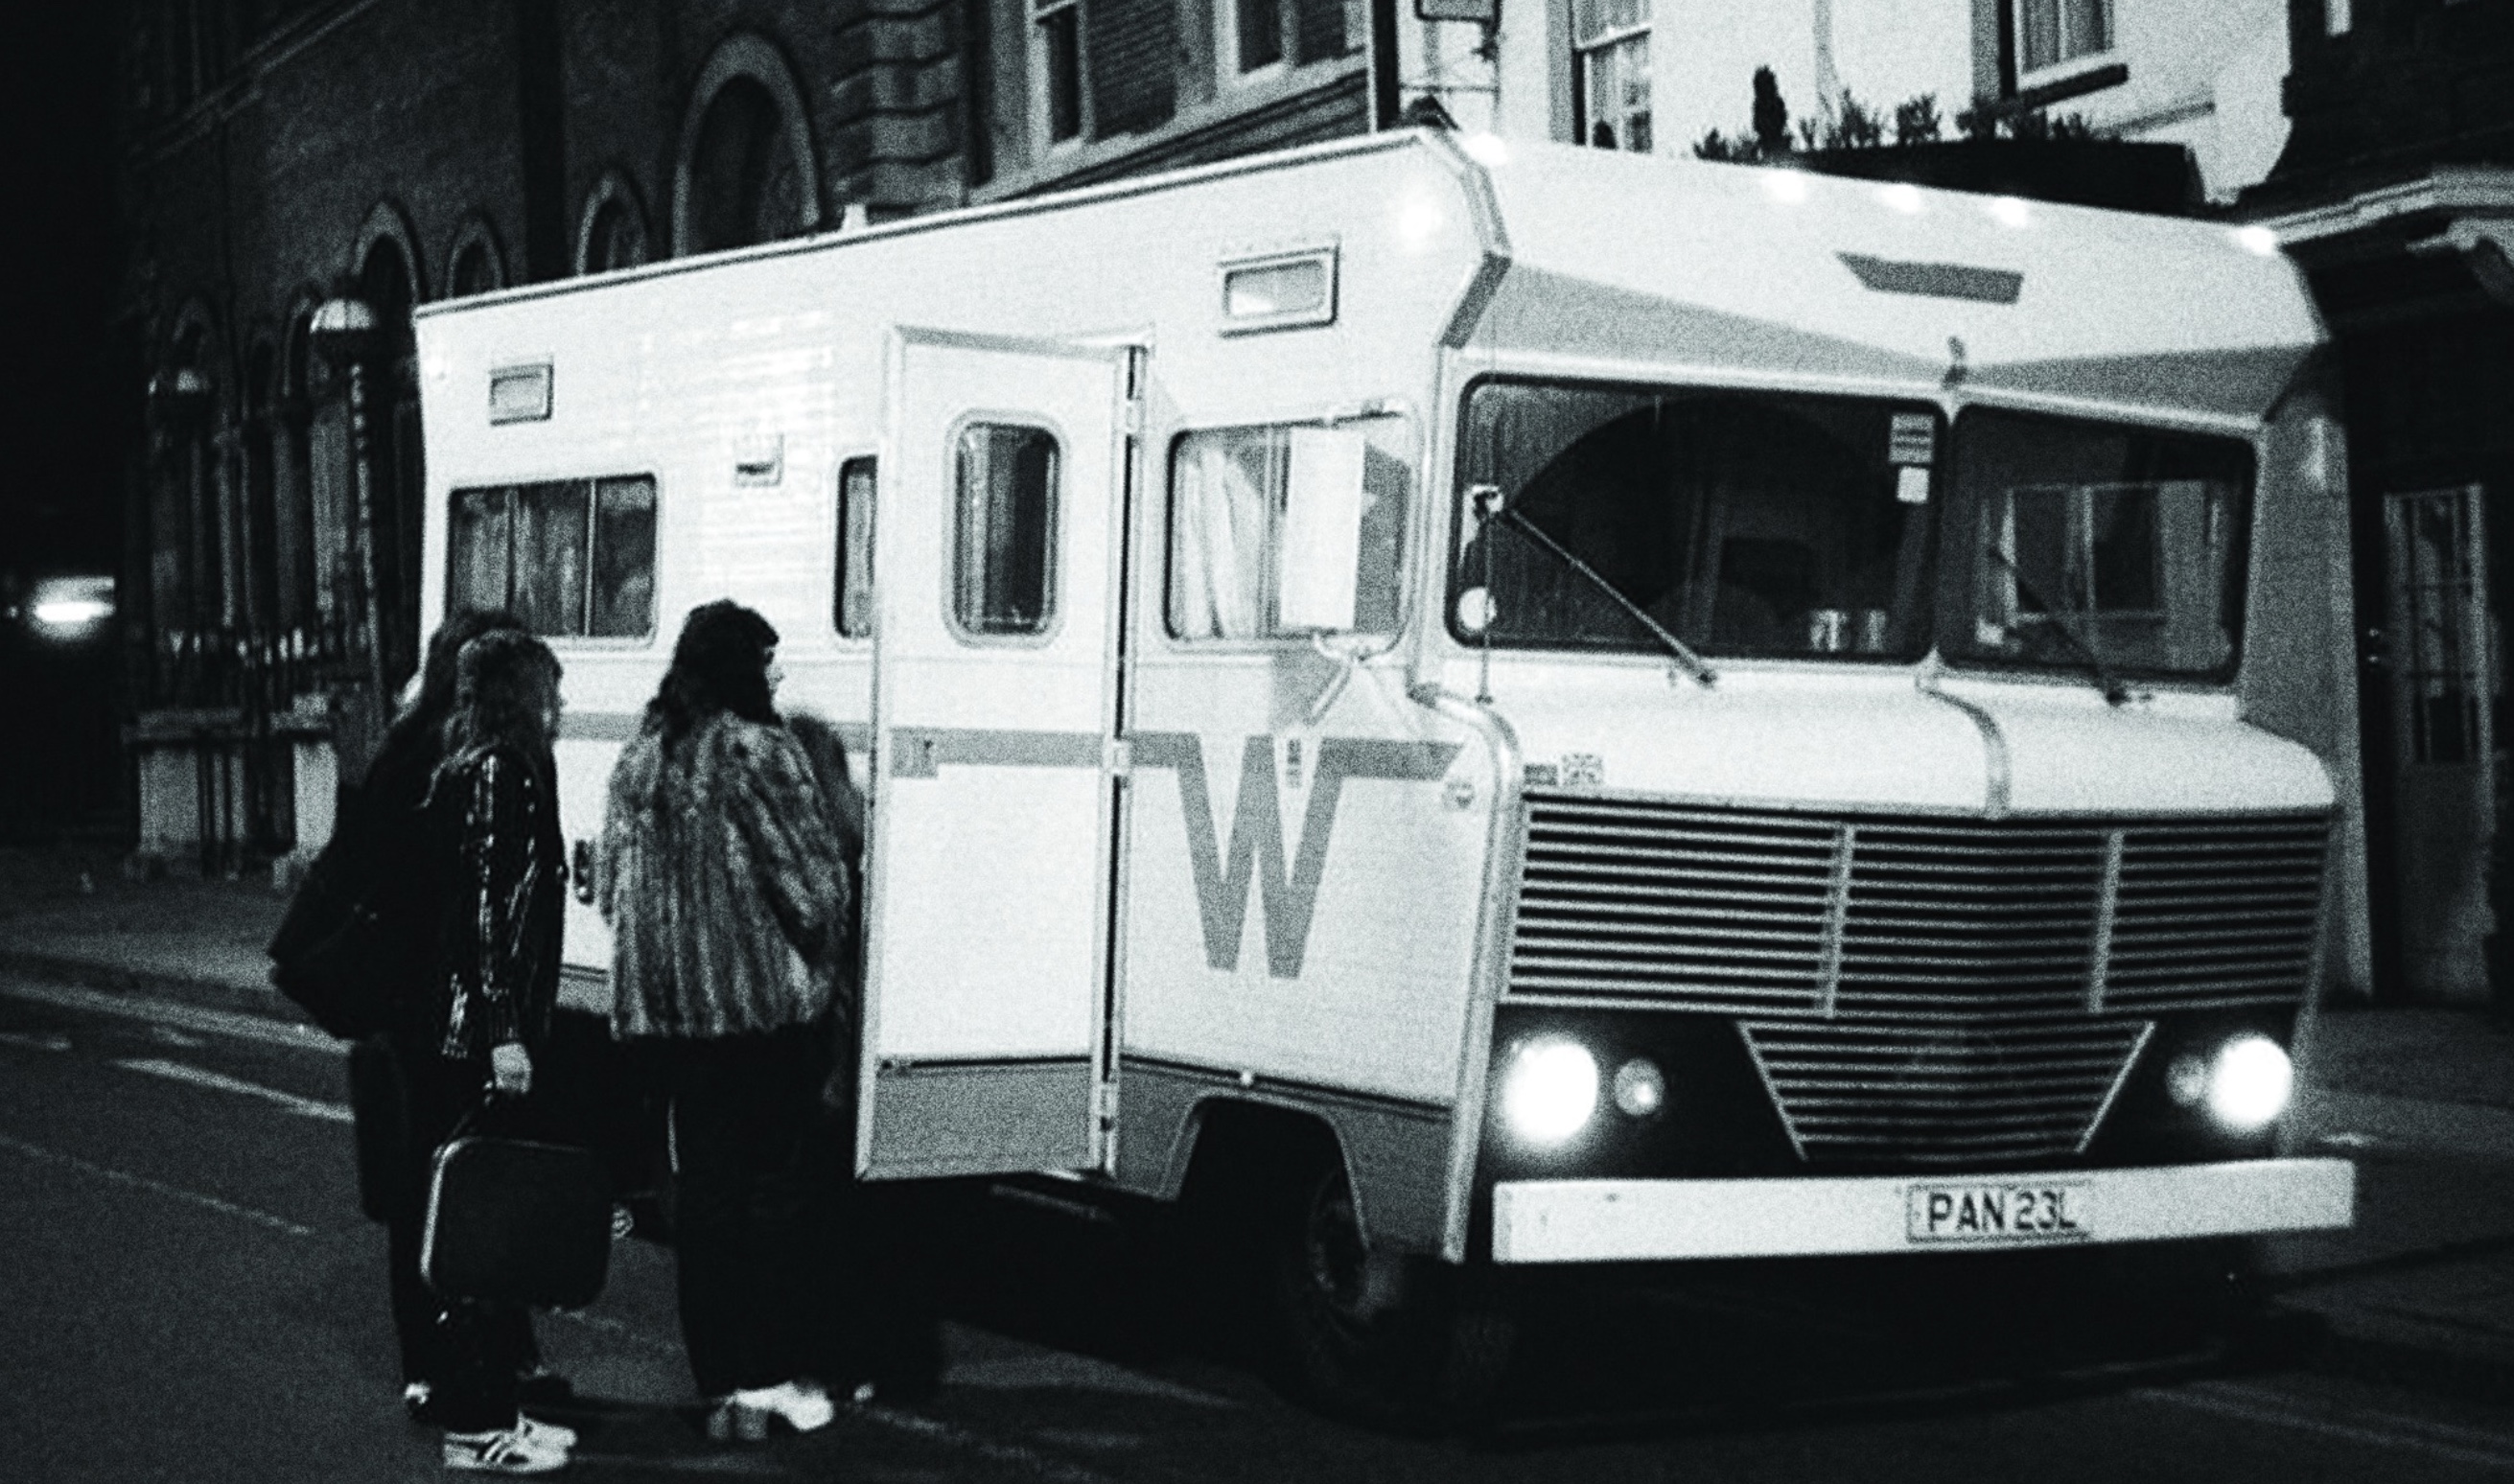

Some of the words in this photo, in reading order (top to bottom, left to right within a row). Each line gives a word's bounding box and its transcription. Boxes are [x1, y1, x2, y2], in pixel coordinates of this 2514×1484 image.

[1176, 731, 1343, 979] W
[1929, 1192, 2005, 1233] PAN
[2014, 1190, 2077, 1230] 23L
